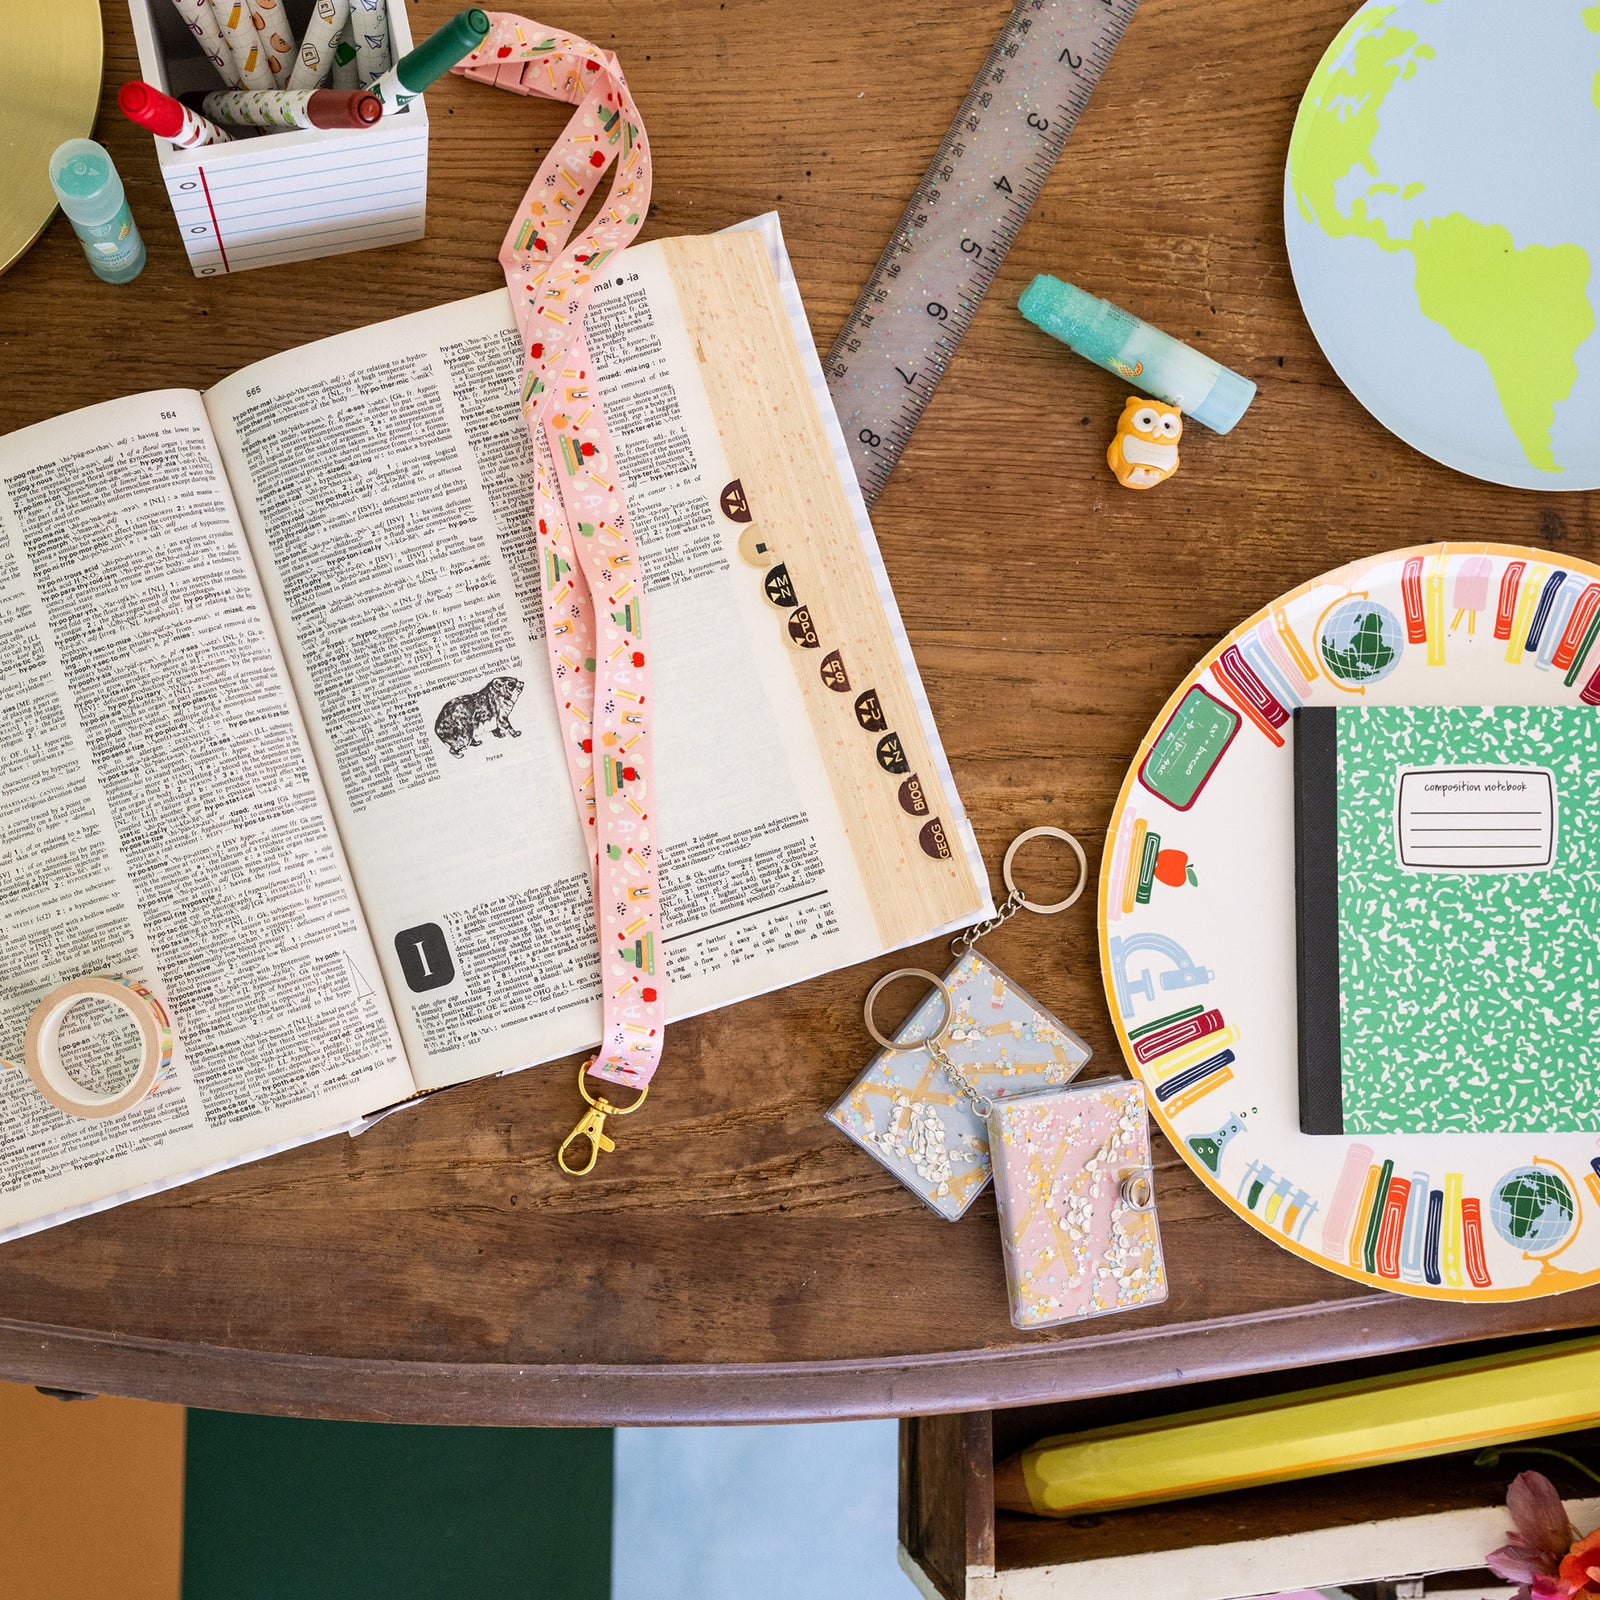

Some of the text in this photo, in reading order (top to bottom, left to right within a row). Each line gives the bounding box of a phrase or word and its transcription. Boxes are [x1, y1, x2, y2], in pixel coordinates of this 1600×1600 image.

[1018, 18, 1032, 34] 26
[1005, 42, 1020, 59] 25
[1058, 48, 1082, 69] 2
[991, 67, 1006, 84] 24
[978, 91, 993, 108] 23
[966, 115, 981, 132] 22
[1027, 113, 1049, 131] 3
[952, 142, 966, 158] 21
[565, 148, 584, 172] A+
[940, 165, 954, 182] 20
[994, 176, 1013, 194] 4
[927, 190, 941, 205] 19
[914, 214, 928, 229] 18
[901, 239, 914, 253] 17
[960, 238, 982, 258] 5
[626, 272, 640, 282] -ia
[888, 264, 902, 279] 16
[587, 288, 646, 311] flourishing spring]
[603, 301, 626, 312] twisted
[626, 293, 647, 305] leaves
[874, 290, 888, 303] 15
[927, 302, 948, 321] 6
[589, 318, 642, 338] ancient Hebrews
[861, 314, 875, 328] 14
[547, 328, 563, 350] A+
[605, 321, 654, 340] highly aromatic
[456, 344, 481, 354] Chinese
[483, 339, 500, 349] green
[848, 338, 861, 353] 13
[366, 362, 391, 373] relating
[835, 363, 849, 378] 12
[895, 367, 918, 384] 7
[468, 374, 494, 386] pungent
[494, 369, 514, 378] leaves
[620, 376, 646, 389] removal
[246, 385, 263, 398] 565
[627, 406, 644, 414] upon
[649, 399, 665, 407] body
[465, 416, 489, 426] remove
[502, 407, 522, 416] uterus
[614, 410, 670, 431] magnetic material
[137, 431, 159, 440] having
[362, 442, 390, 456] inference
[390, 439, 407, 448] from
[407, 430, 436, 443] observed
[645, 439, 666, 449] former
[667, 433, 688, 443] notion
[859, 429, 881, 447] 8
[619, 457, 653, 470] excitability
[666, 445, 691, 456] disturb-
[106, 492, 132, 503] uniform
[132, 482, 171, 495] temperature
[584, 494, 602, 516] A+
[614, 660, 631, 683] A+
[413, 748, 433, 759] broad
[485, 753, 504, 763] hyrax
[414, 768, 439, 779] incisors
[908, 780, 926, 812] BIOG
[1424, 781, 1527, 797] composition notebook
[618, 819, 637, 844] A+
[686, 841, 705, 852] vowel
[715, 834, 731, 843] most
[732, 828, 752, 838] nouns
[767, 814, 798, 827] adjectives
[687, 845, 720, 859] connective
[721, 838, 740, 848] vowel
[749, 832, 762, 841] join
[763, 825, 780, 835] word
[781, 818, 809, 830] elements
[930, 824, 951, 860] GEOG
[708, 847, 783, 874] suffix forming feminine
[41, 897, 58, 907] made
[463, 917, 489, 932] graphic
[490, 903, 534, 920] representation
[562, 888, 579, 898] letter
[64, 903, 124, 926] with hollow needle
[705, 934, 726, 945] further
[742, 924, 757, 933] back
[819, 901, 831, 909] cart
[413, 940, 434, 978] I
[470, 961, 563, 995] Indian industrial initial
[440, 1007, 464, 1019] positive
[465, 1001, 488, 1013] square
[487, 996, 501, 1004] root
[511, 987, 531, 996] minus
[622, 992, 641, 1018] A+
[138, 1130, 167, 1144] abnormal
[34, 1151, 59, 1162] muscles
[78, 1138, 100, 1148] tongue
